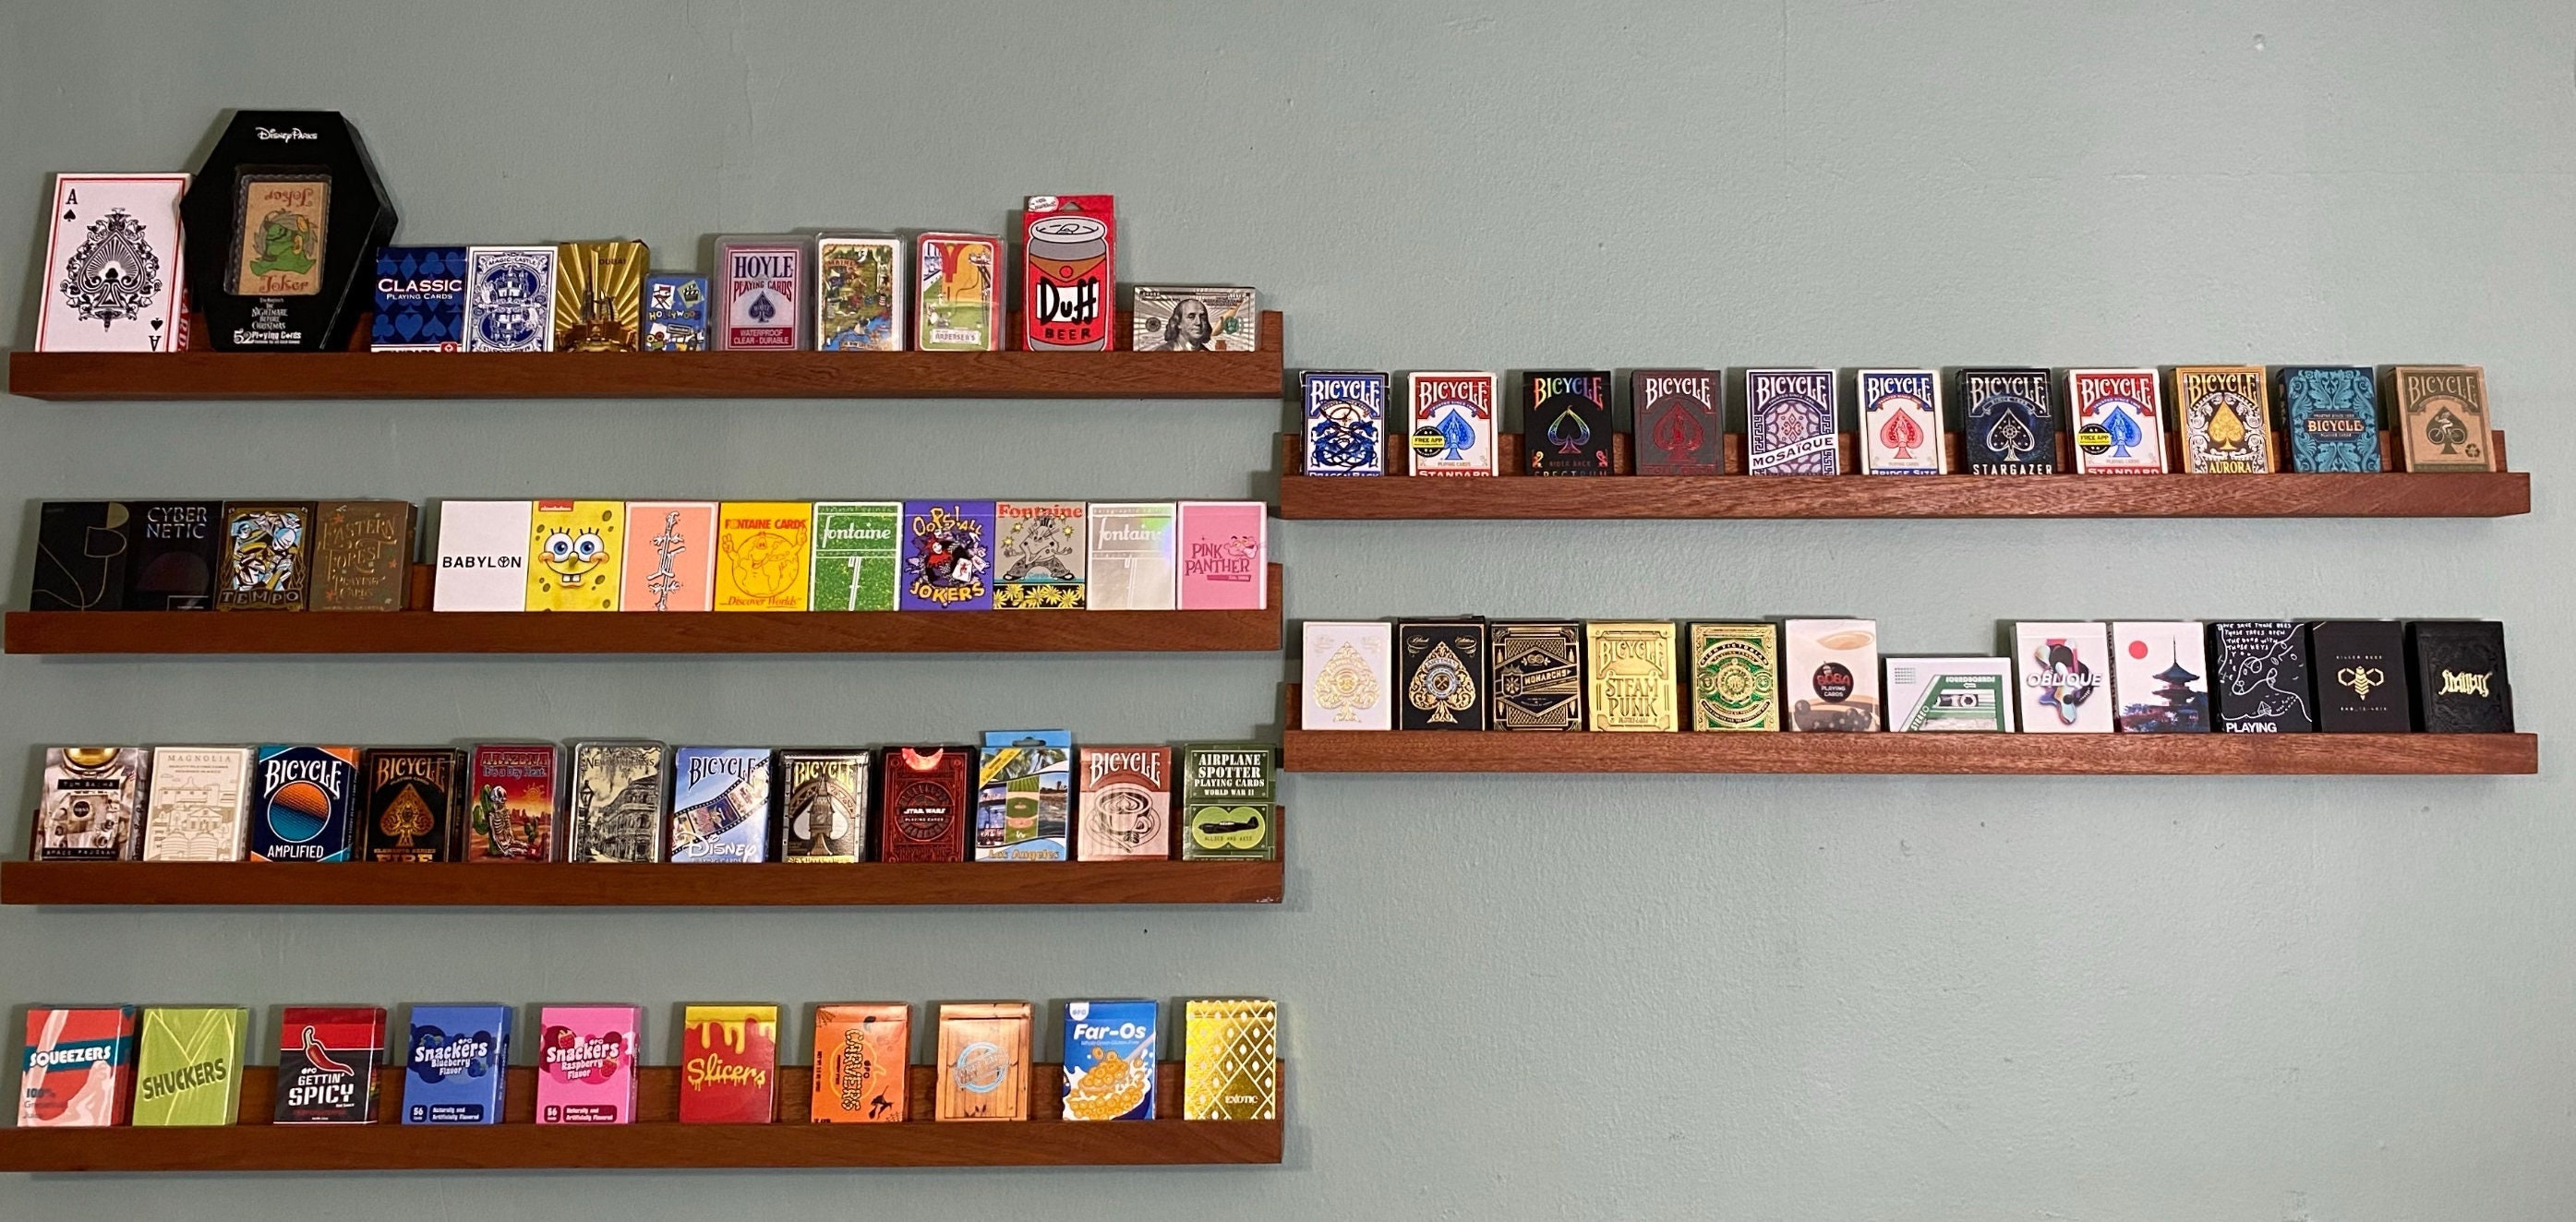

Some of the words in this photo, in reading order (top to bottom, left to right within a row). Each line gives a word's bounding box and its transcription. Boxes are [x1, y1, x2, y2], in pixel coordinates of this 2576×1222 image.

[256, 127, 292, 143] Disney
[66, 188, 78, 205] A
[488, 257, 512, 266] MAGIC
[514, 257, 536, 266] CASTLE
[733, 256, 794, 279] HOYLE
[259, 275, 309, 293] Joker
[378, 278, 463, 293] CLASSIC
[733, 280, 764, 304] PLAYING
[767, 280, 793, 303] CARDS
[1041, 276, 1101, 325] Duff
[234, 329, 255, 344] 52
[740, 329, 784, 337] WATERPROOF
[1045, 328, 1091, 341] BEER
[1310, 380, 1380, 416] BICYCLE
[1418, 381, 1488, 415] BICYCLE
[1534, 377, 1604, 411] BICYCLE
[1645, 377, 1712, 410] BICYCLE
[1756, 376, 1828, 412] BICYCLE
[1867, 377, 1932, 411] BICYCLE
[1970, 377, 2047, 413] BICYCLE
[2081, 378, 2153, 413] BICYCLE
[2187, 373, 2258, 408] BICYCLE
[2408, 376, 2478, 409] BICYCLE
[2307, 419, 2365, 432] BICYCLE
[1973, 464, 2052, 475] STARGAZER
[2209, 461, 2252, 474] AURORA
[147, 507, 208, 522] CYBER
[997, 504, 1083, 519] Fontaine
[146, 523, 206, 539] NETIC
[725, 519, 771, 530] FONTAINE
[822, 515, 891, 548] fontaine
[1191, 543, 1223, 559] PINK
[442, 557, 522, 569] BABYLON
[1185, 557, 1250, 576] PANTHER
[222, 591, 299, 605] TEMPO
[909, 581, 985, 604] JOKERS
[1598, 640, 1667, 675] BICYCLE
[1524, 669, 1567, 685] MONARCHS
[2027, 673, 2102, 689] OBLIQUE
[1606, 677, 1658, 698] STEAM
[1607, 698, 1658, 717] PUNK
[1910, 705, 1930, 731] STEREO
[2226, 723, 2277, 733] PLAYING
[481, 751, 549, 766] ARIZONA
[1198, 753, 1261, 766] AIRPLANE
[263, 760, 343, 799] BICYCLE
[375, 757, 445, 793] BICYCLE
[689, 757, 756, 791] BICYCLE
[792, 760, 854, 794] BICYCLE
[1089, 752, 1161, 789] BICYCLE
[1198, 766, 1261, 778] SPOTTER
[1194, 779, 1233, 787] PLAYING
[1234, 779, 1265, 787] CARDS
[267, 845, 324, 858] AMPLIFIED
[988, 848, 1008, 859] Los
[1010, 848, 1060, 860] Angeles
[1073, 1022, 1147, 1040] Far-Os
[30, 1045, 112, 1068] SQUEEZERS
[415, 1042, 488, 1062] Snackers
[546, 1042, 620, 1063] Snackers
[431, 1058, 471, 1068] Blueberry
[439, 1067, 463, 1076] Flavor
[561, 1059, 604, 1072] Raspberry
[687, 1052, 766, 1090] Slicers
[841, 1028, 865, 1111] CARVERS
[142, 1058, 227, 1102] SHUCKERS
[297, 1072, 345, 1086] GETTIN'
[567, 1069, 591, 1080] Flavor
[288, 1084, 355, 1107] SPICY
[413, 1107, 424, 1116] 56
[547, 1107, 558, 1117] 56
